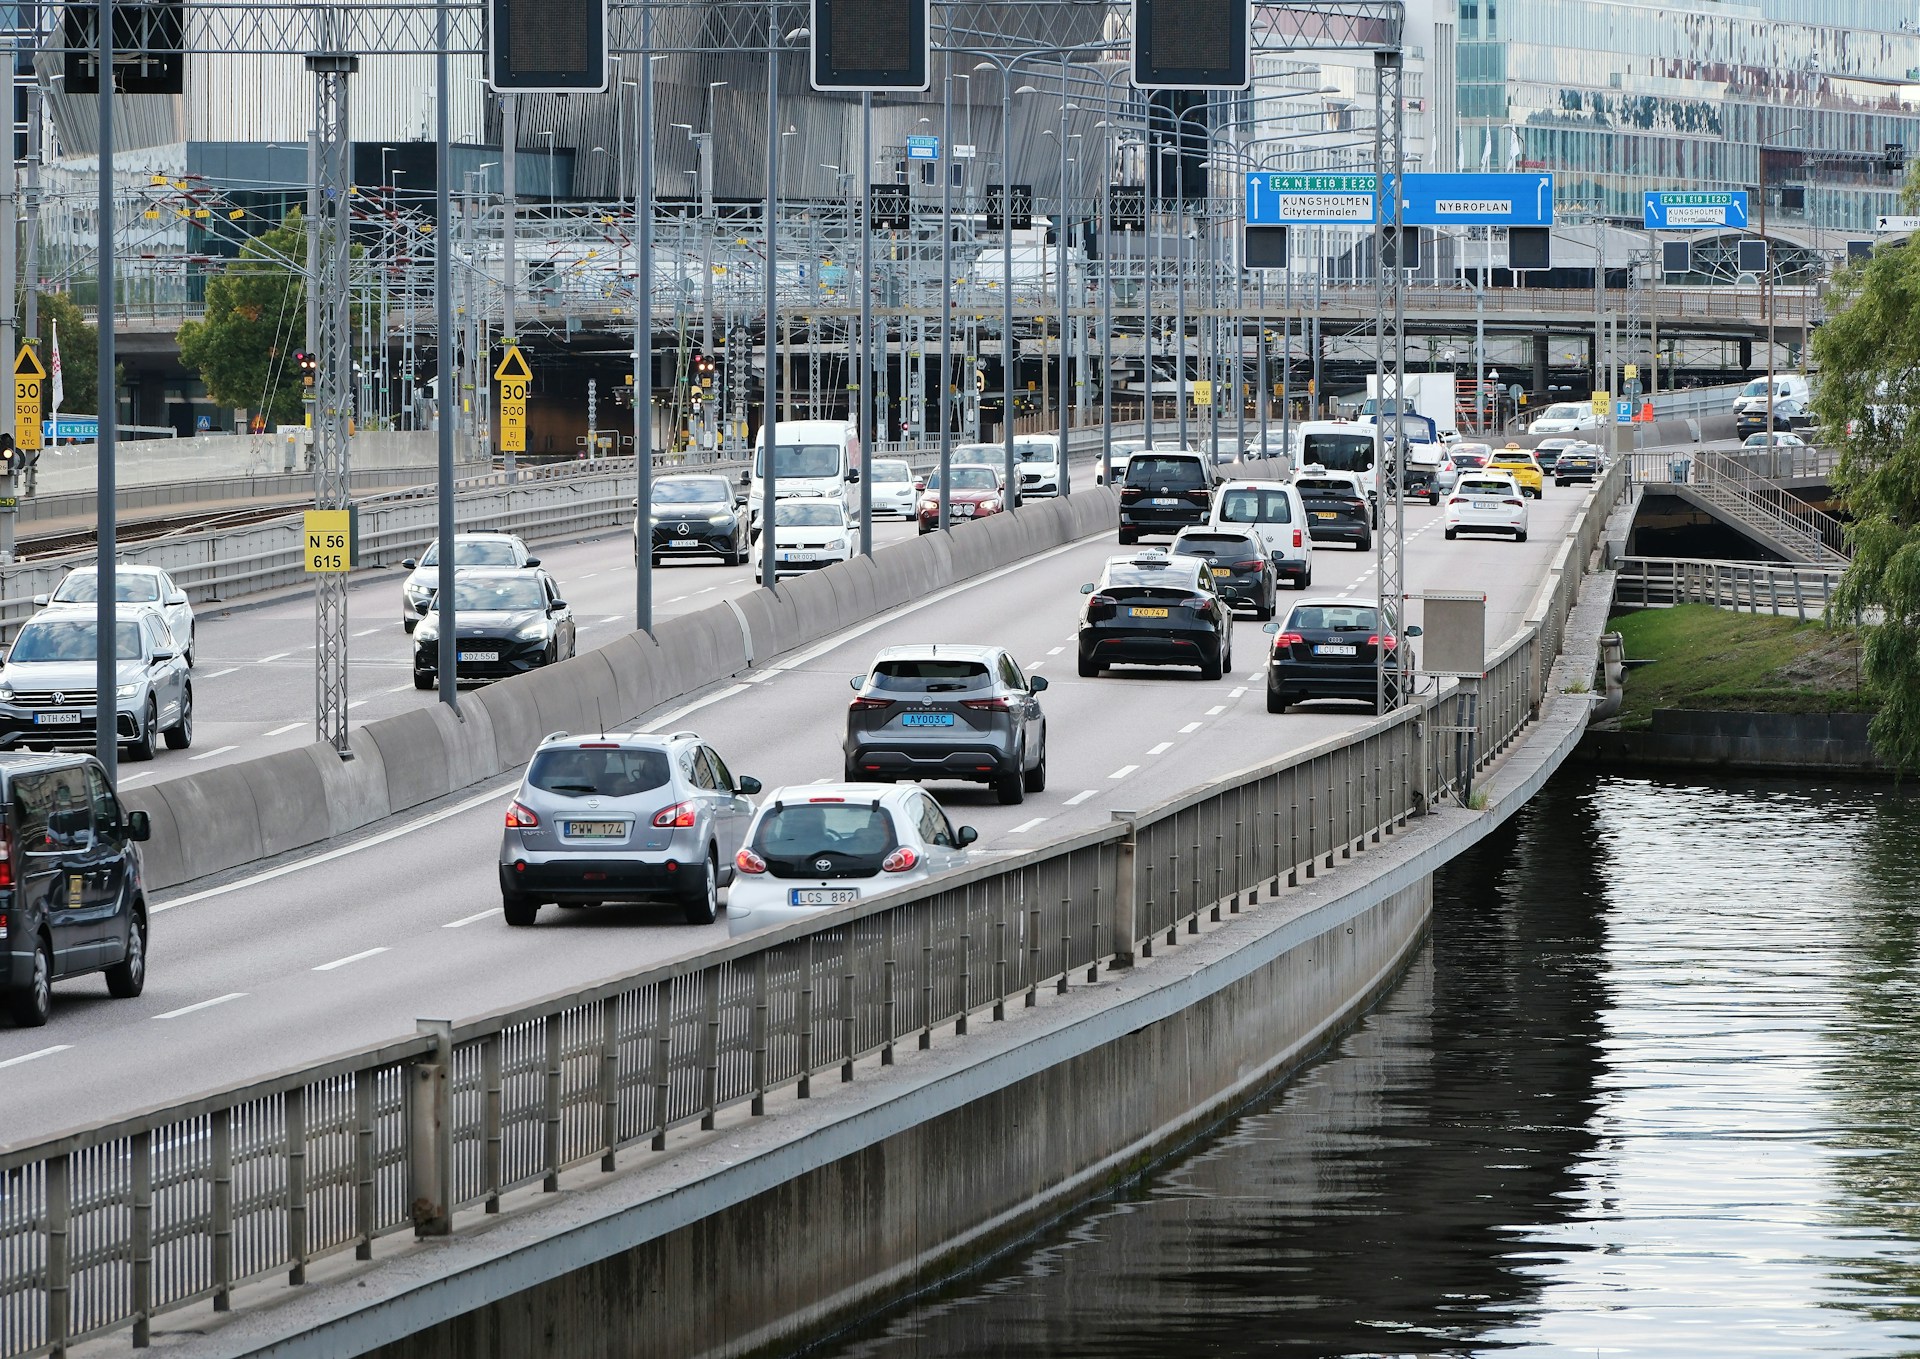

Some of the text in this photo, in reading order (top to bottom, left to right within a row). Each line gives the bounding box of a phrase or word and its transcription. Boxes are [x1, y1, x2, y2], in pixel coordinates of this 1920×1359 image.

[1275, 179, 1302, 188] E4 N
[1316, 179, 1336, 188] E18
[1351, 179, 1375, 188] E20
[1282, 197, 1369, 206] KUNGSHOLMEN
[1439, 203, 1508, 211] NYBROPLAN
[1282, 207, 1357, 217] Cityterminalen
[17, 383, 39, 399] 30
[502, 385, 524, 400] 30
[17, 405, 39, 414] 500
[502, 406, 524, 416] 500
[310, 535, 344, 548] N 56
[314, 555, 341, 568] 615
[1151, 608, 1165, 616] 747
[1339, 646, 1354, 654] 511
[41, 714, 77, 723] DTH 65M
[910, 715, 947, 724] AY003C
[571, 824, 622, 834] PWW 174
[800, 891, 854, 903] LCS 882
